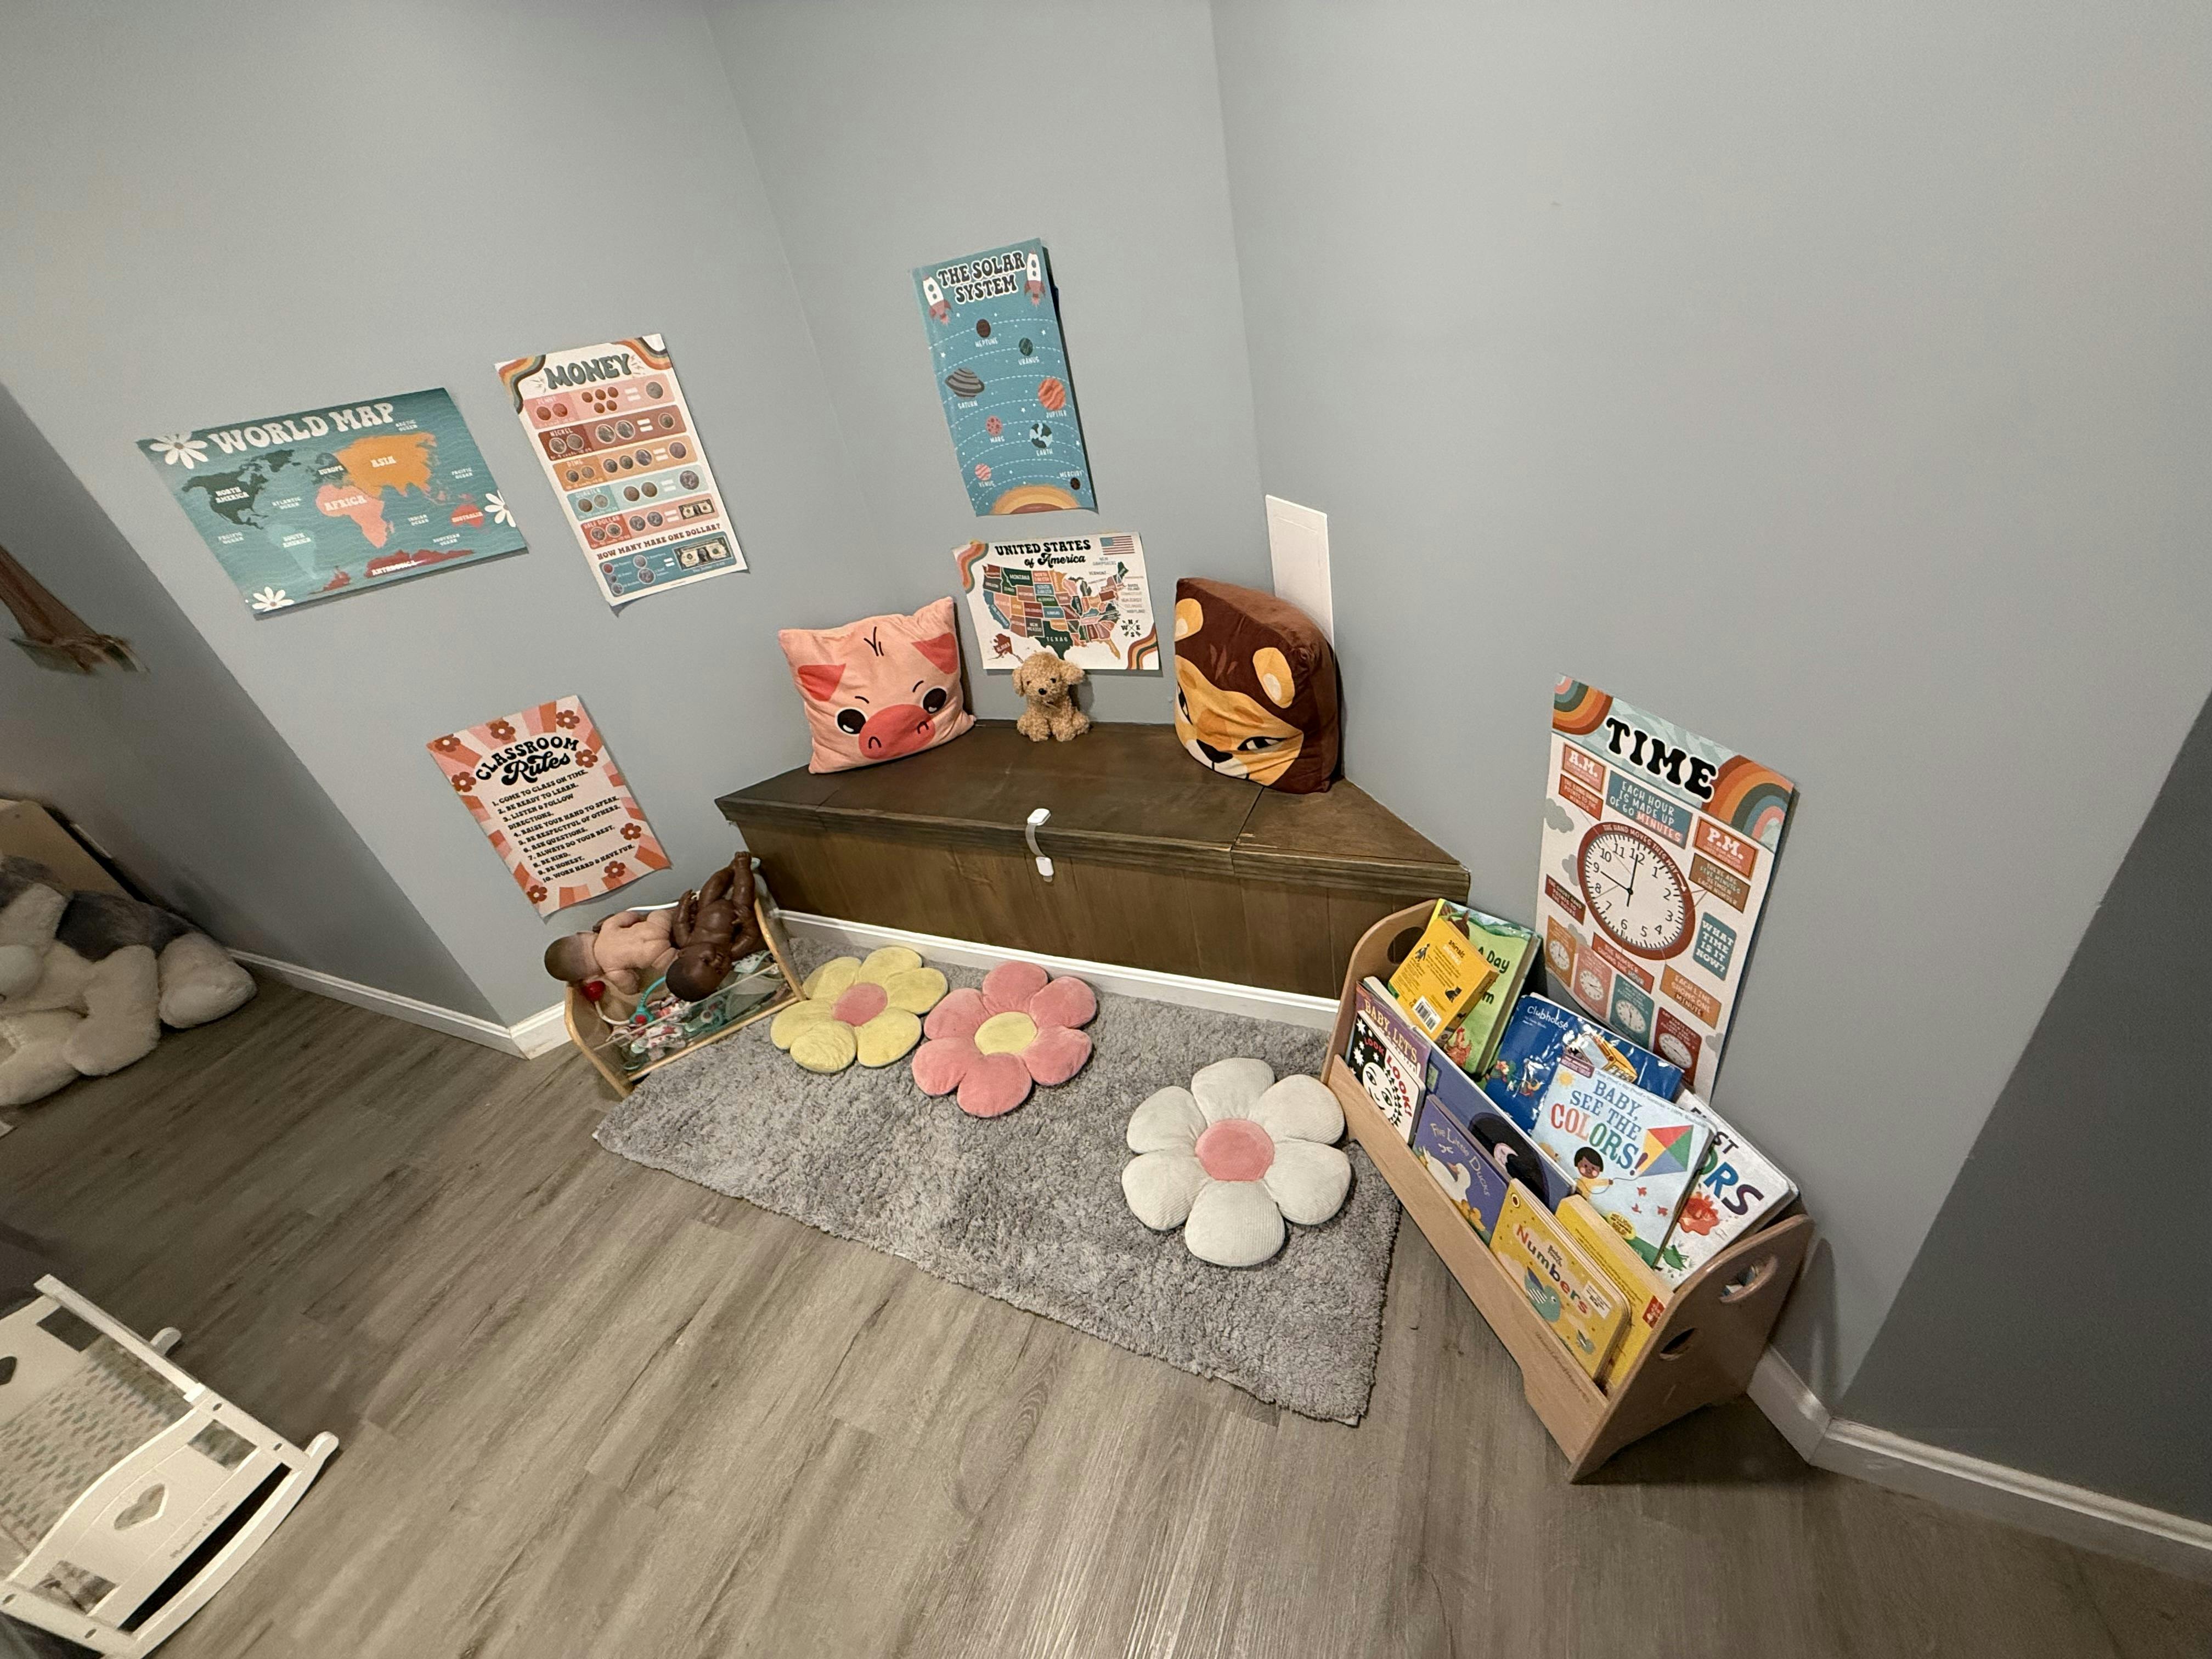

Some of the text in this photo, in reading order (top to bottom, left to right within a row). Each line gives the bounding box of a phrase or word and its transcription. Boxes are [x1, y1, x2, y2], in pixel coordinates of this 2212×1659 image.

[937, 251, 1026, 287] THE SOLAR
[955, 275, 1018, 303] SYSTEM
[975, 337, 998, 347] NEPTUNE
[543, 353, 631, 390] MONEY
[1018, 356, 1040, 365] URANUS
[957, 400, 978, 409] SATURN
[1046, 410, 1067, 419] JUPITER
[207, 402, 394, 454] WORLD MAP
[550, 427, 573, 437] NICKEL
[370, 455, 397, 468] ASIA
[1036, 448, 1053, 456] EARTH
[318, 465, 345, 476] EUROPE
[1059, 470, 1084, 478] MERCURY
[215, 486, 242, 497] NORTH
[215, 492, 250, 504] AMERICA
[324, 495, 368, 511] AFRICA
[597, 549, 616, 560] HOW
[618, 543, 641, 554] MANY
[643, 537, 667, 548] MAKE
[668, 533, 685, 541] ONE
[686, 523, 720, 537] DOLLAR?
[995, 539, 1091, 556] UNITED STATES
[1024, 558, 1035, 568] of
[1037, 552, 1086, 568] America
[475, 736, 580, 780] CLASSROOM
[501, 750, 571, 786] Rules
[1568, 749, 1598, 778] A.M.
[1605, 716, 1717, 800] TIME
[498, 793, 521, 804] COME
[532, 781, 556, 793] CLASS
[556, 776, 567, 785] ON
[567, 769, 588, 780] TIME.
[516, 795, 540, 808] READY
[552, 783, 579, 795] LEARN.
[511, 806, 538, 820] LISTEN
[543, 793, 573, 808] FOLLOW
[1619, 790, 1675, 826] IS MADE UP
[1622, 781, 1645, 801] EACH
[1647, 795, 1675, 817] HOUR
[507, 811, 554, 831] DIRECTIONS.
[521, 823, 544, 835] RAISE
[543, 817, 564, 827] YOUR
[563, 809, 584, 820] HAND
[595, 795, 620, 808] SPEAK.
[536, 820, 581, 839] RESPECTFUL
[591, 805, 620, 819] OTHERS.
[1610, 796, 1683, 843] OF 60 MINUTES
[531, 842, 546, 850] ASK
[546, 827, 588, 845] QUESTIONS.
[536, 844, 566, 857] ALWAYS
[576, 833, 596, 843] YOUR
[595, 825, 616, 836] BEST.
[1613, 825, 1629, 833] HAND
[1629, 829, 1654, 846] MOVES
[1652, 843, 1668, 859] THIS
[1666, 859, 1678, 873] WAY
[1707, 827, 1744, 860] P.M.
[551, 853, 571, 862] KIND.
[553, 868, 574, 878] WORK
[574, 861, 594, 871] HARD
[600, 850, 619, 862] HAVE
[619, 844, 635, 854] FUN.
[555, 856, 585, 868] HONEST.
[1599, 848, 1612, 862] 10
[1613, 843, 1625, 859] 11
[1629, 848, 1645, 865] 12
[1593, 862, 1600, 873] 9
[1651, 867, 1658, 879] 1
[1594, 883, 1602, 894] 8
[1663, 888, 1672, 901] 2
[1605, 900, 1612, 911] 7
[1664, 910, 1673, 922] 3
[1621, 918, 1628, 930] 6
[1640, 926, 1648, 938] 5
[1654, 924, 1662, 935] 4
[1702, 920, 1734, 946] WHAT
[1448, 939, 1466, 958] animals
[1701, 941, 1725, 962] IS IT
[1702, 931, 1730, 955] TIME
[1486, 950, 1510, 974] Day
[1695, 948, 1725, 972] NOW?
[1671, 982, 1711, 1013] SHOWS ONE
[1674, 975, 1711, 1004] EACH LINE
[1675, 994, 1702, 1016] MINUTE
[1526, 1006, 1569, 1030] Clubhouse
[1364, 998, 1391, 1034] BABY,
[1393, 1026, 1418, 1062] LET'S
[1363, 1036, 1385, 1056] LOOK
[1386, 1055, 1413, 1117] LOOK!
[1593, 1079, 1642, 1121] BABY,
[1570, 1090, 1604, 1116] SEE
[1606, 1107, 1642, 1141] THE
[1550, 1102, 1648, 1176] COLORS!
[1516, 1223, 1588, 1314] Numbers
